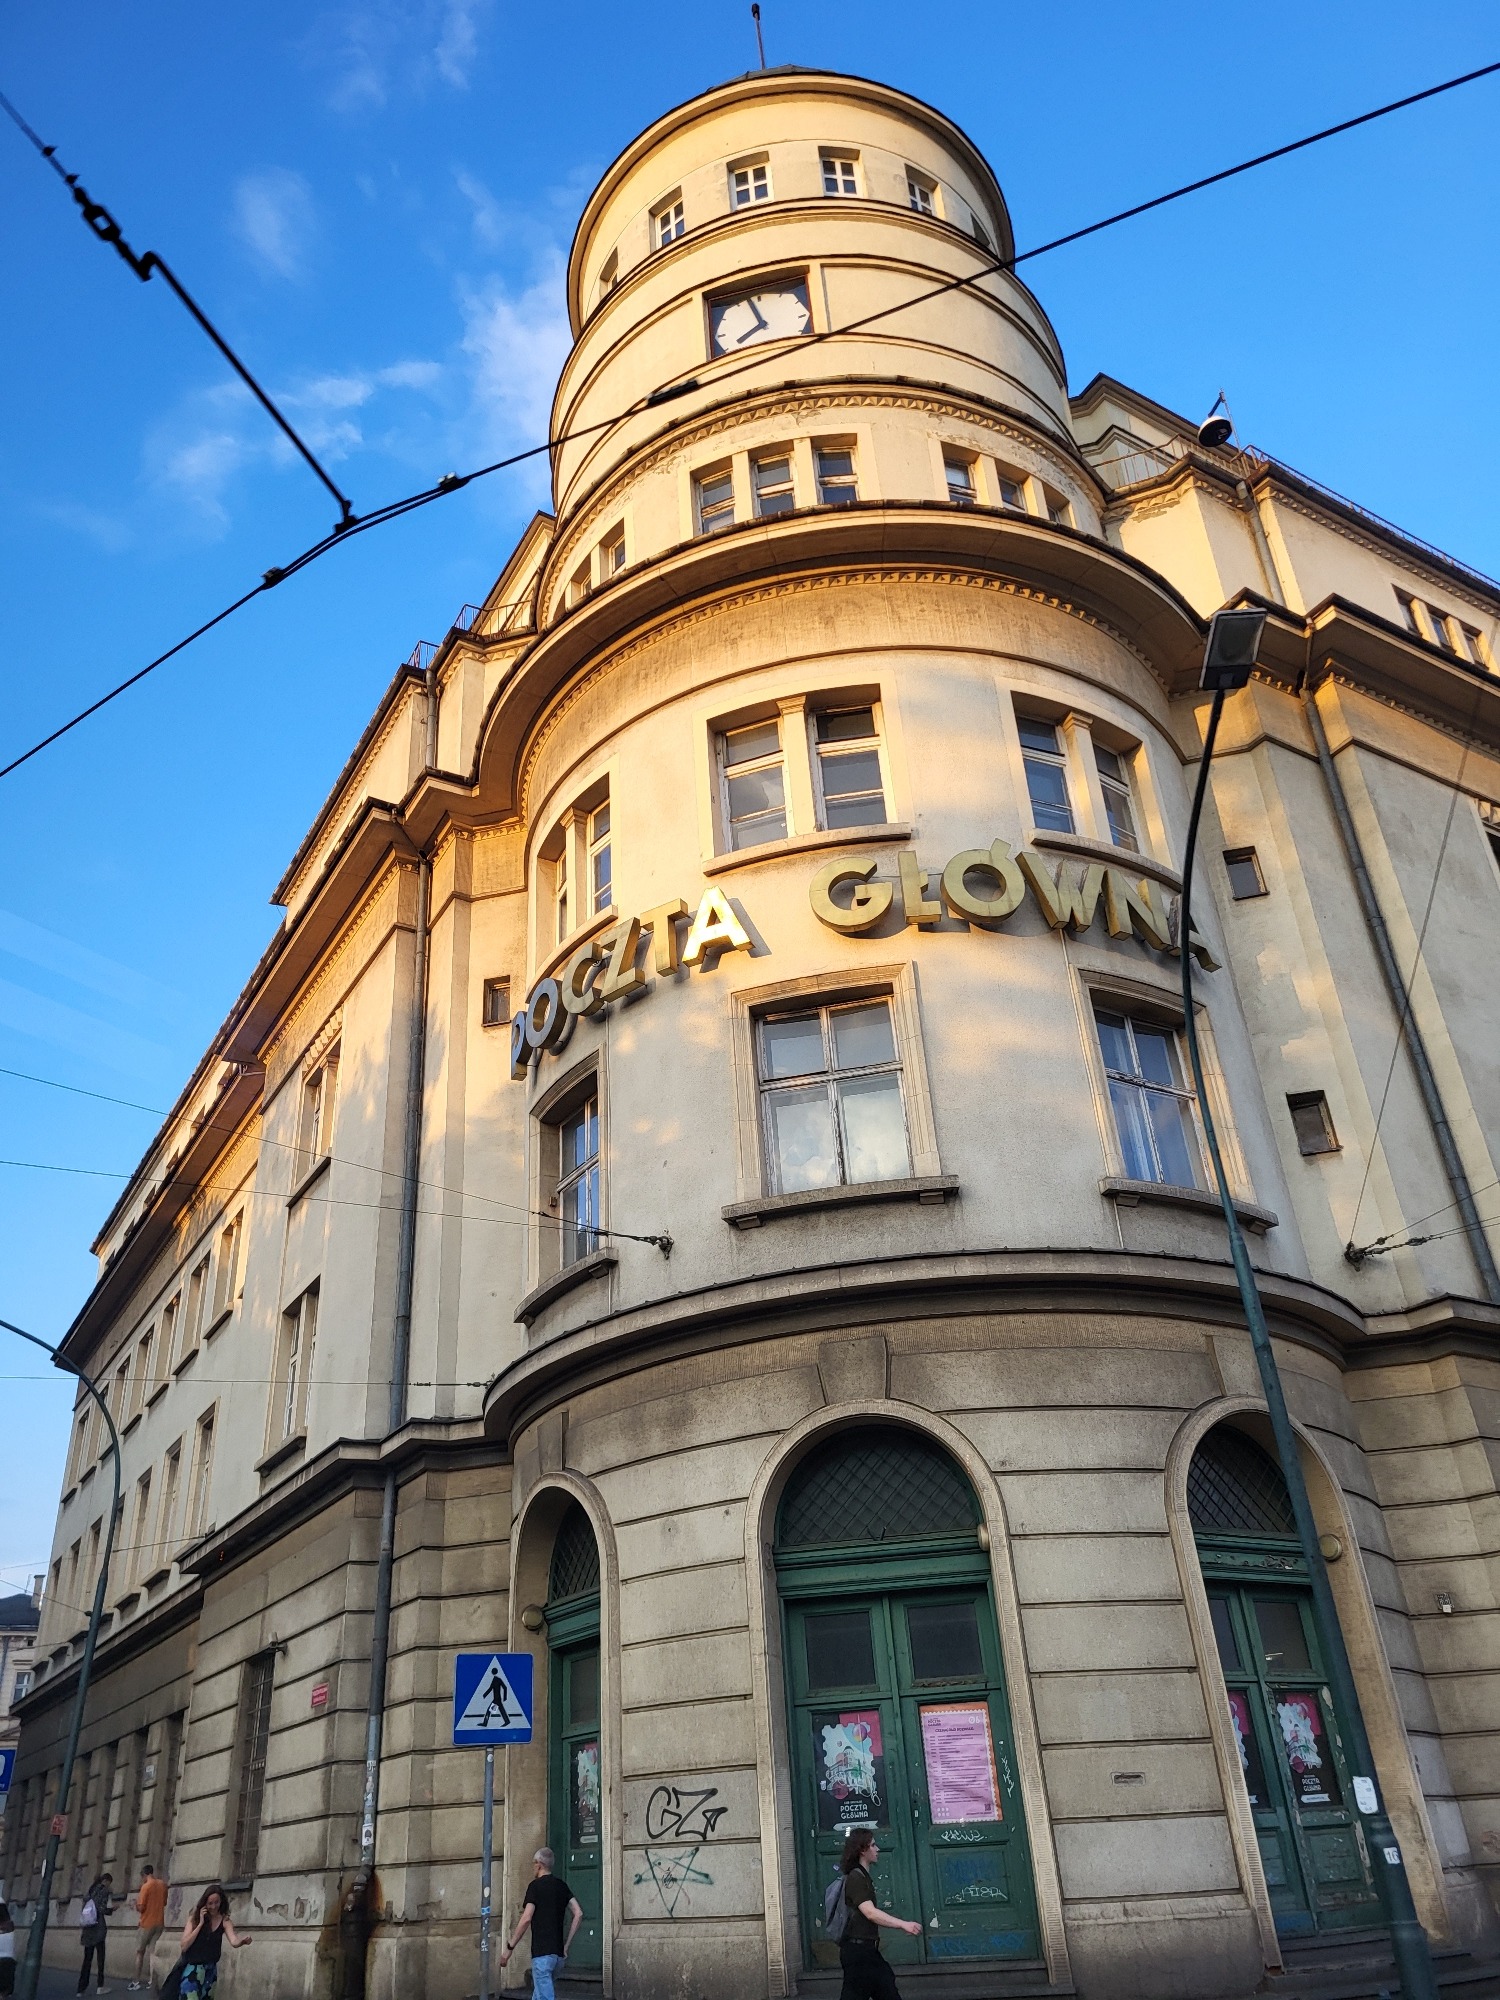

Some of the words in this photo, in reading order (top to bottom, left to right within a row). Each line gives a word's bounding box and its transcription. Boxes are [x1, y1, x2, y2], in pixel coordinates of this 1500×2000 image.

[511, 885, 755, 1081] POCZTA
[809, 838, 1222, 972] GŁÓWNA
[840, 1804, 868, 1812] POCZTA
[841, 1811, 869, 1819] GŁÓWNA
[1386, 1850, 1399, 1862] 16
